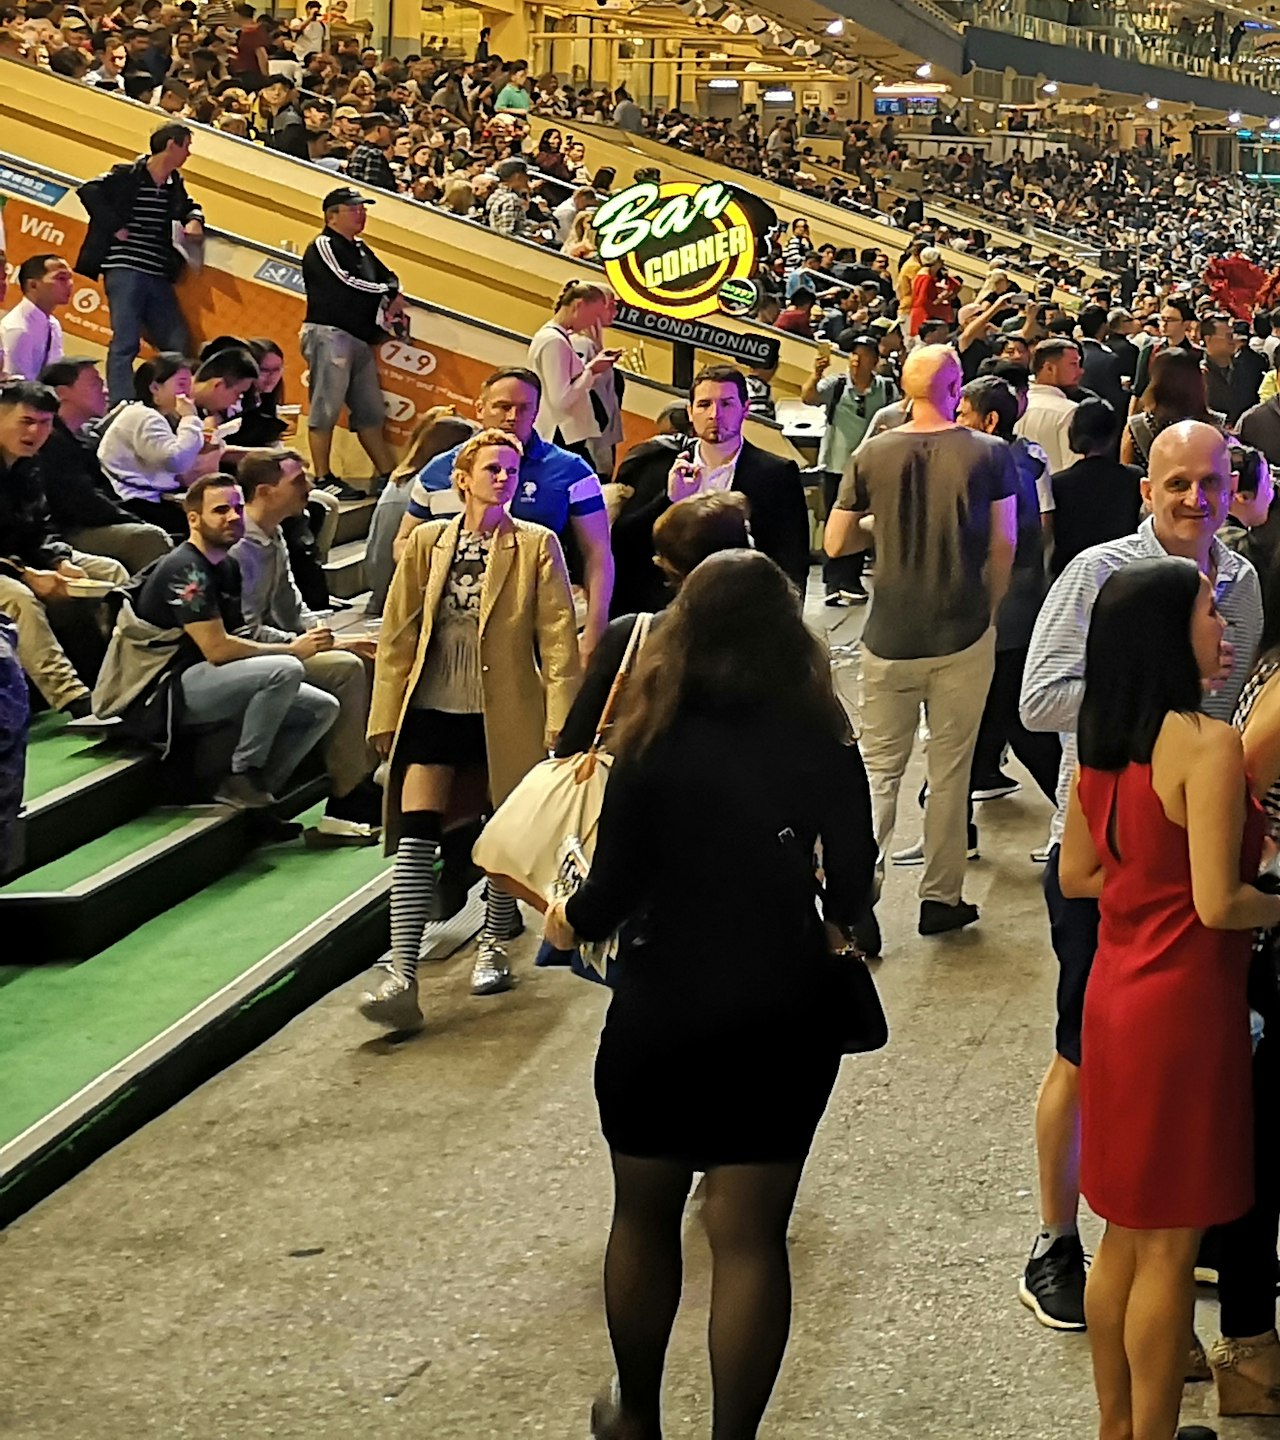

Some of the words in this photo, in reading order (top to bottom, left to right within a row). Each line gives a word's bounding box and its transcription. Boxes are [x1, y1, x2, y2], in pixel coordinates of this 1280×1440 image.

[20, 214, 65, 246] Win
[593, 182, 732, 259] Bar
[644, 224, 747, 289] CORNER
[644, 313, 771, 357] CONDITIONING
